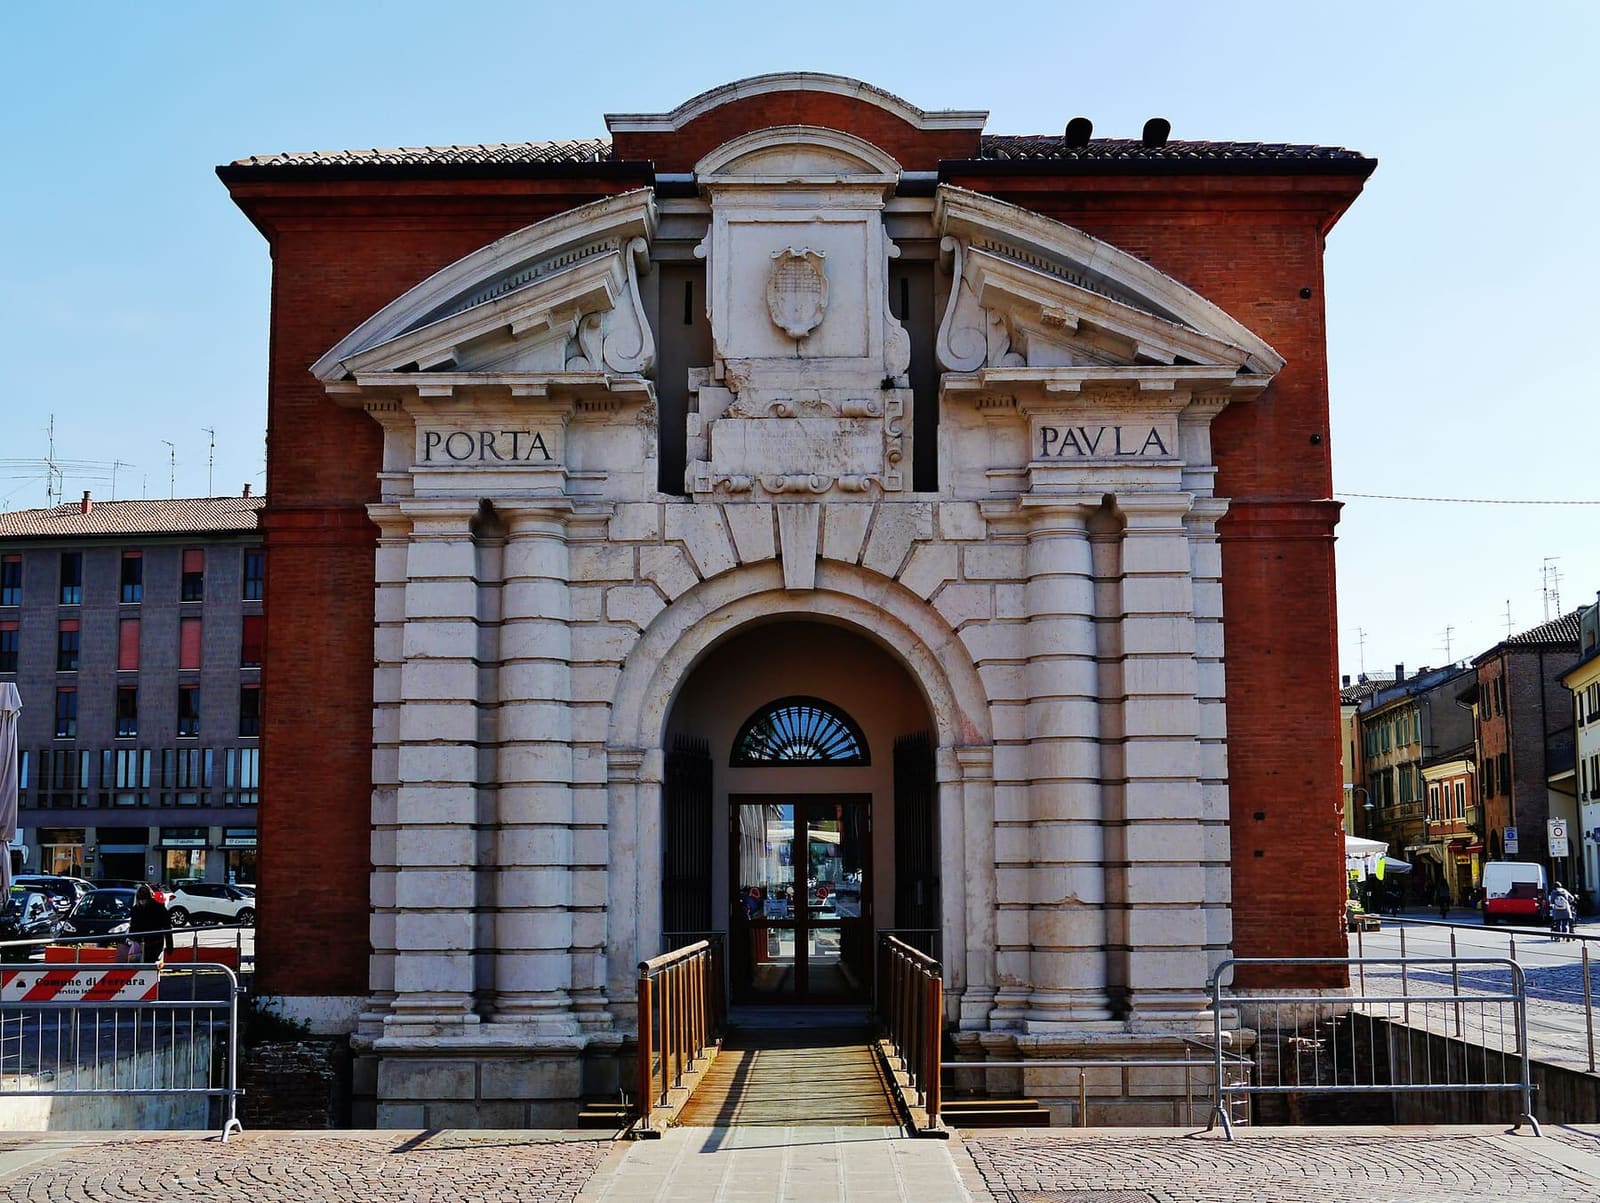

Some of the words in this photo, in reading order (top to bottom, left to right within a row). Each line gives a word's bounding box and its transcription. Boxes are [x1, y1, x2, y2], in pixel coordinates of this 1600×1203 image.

[424, 431, 553, 461] PORTA
[1040, 426, 1170, 457] PAVLA
[35, 977, 81, 987] Comune
[85, 977, 97, 986] di
